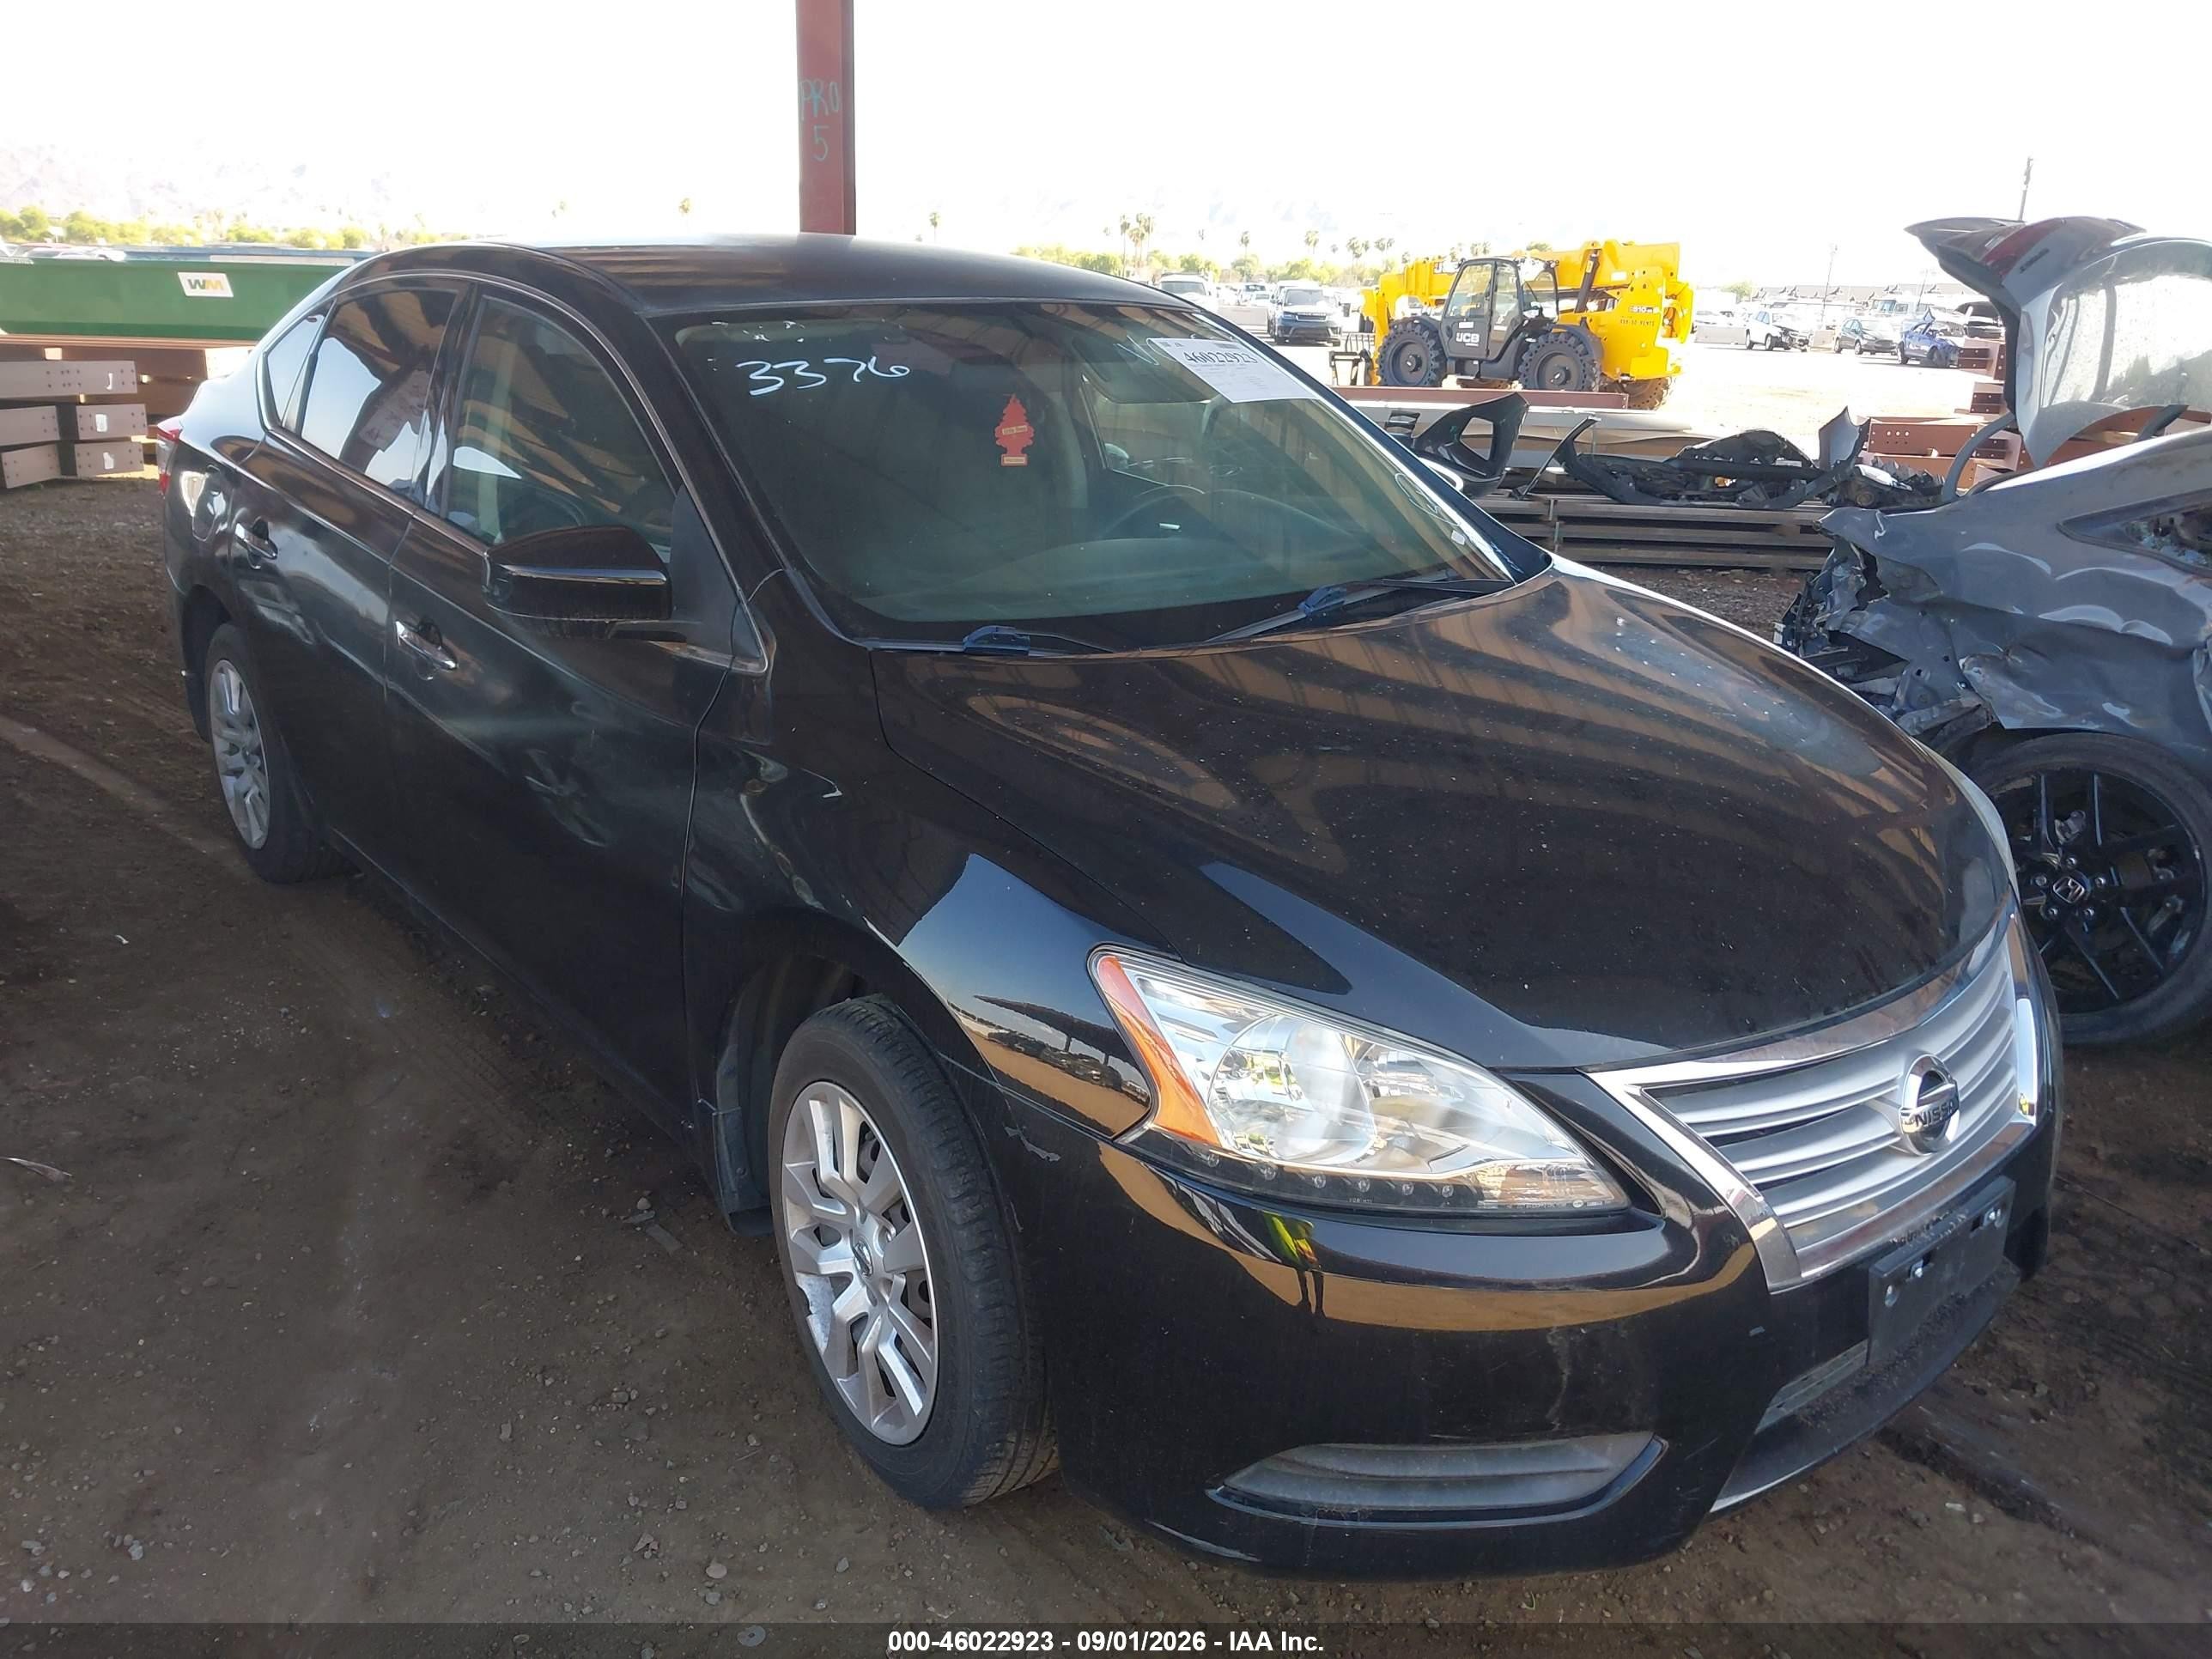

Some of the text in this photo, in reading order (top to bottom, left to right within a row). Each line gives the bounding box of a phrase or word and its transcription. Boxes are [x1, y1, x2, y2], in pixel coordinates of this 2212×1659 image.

[811, 125, 830, 161] 5
[187, 278, 223, 290] WM
[1455, 332, 1480, 343] JCB
[1183, 351, 1258, 364] 46022923
[735, 356, 910, 396] 3376
[1915, 1099, 1954, 1127] NISS
